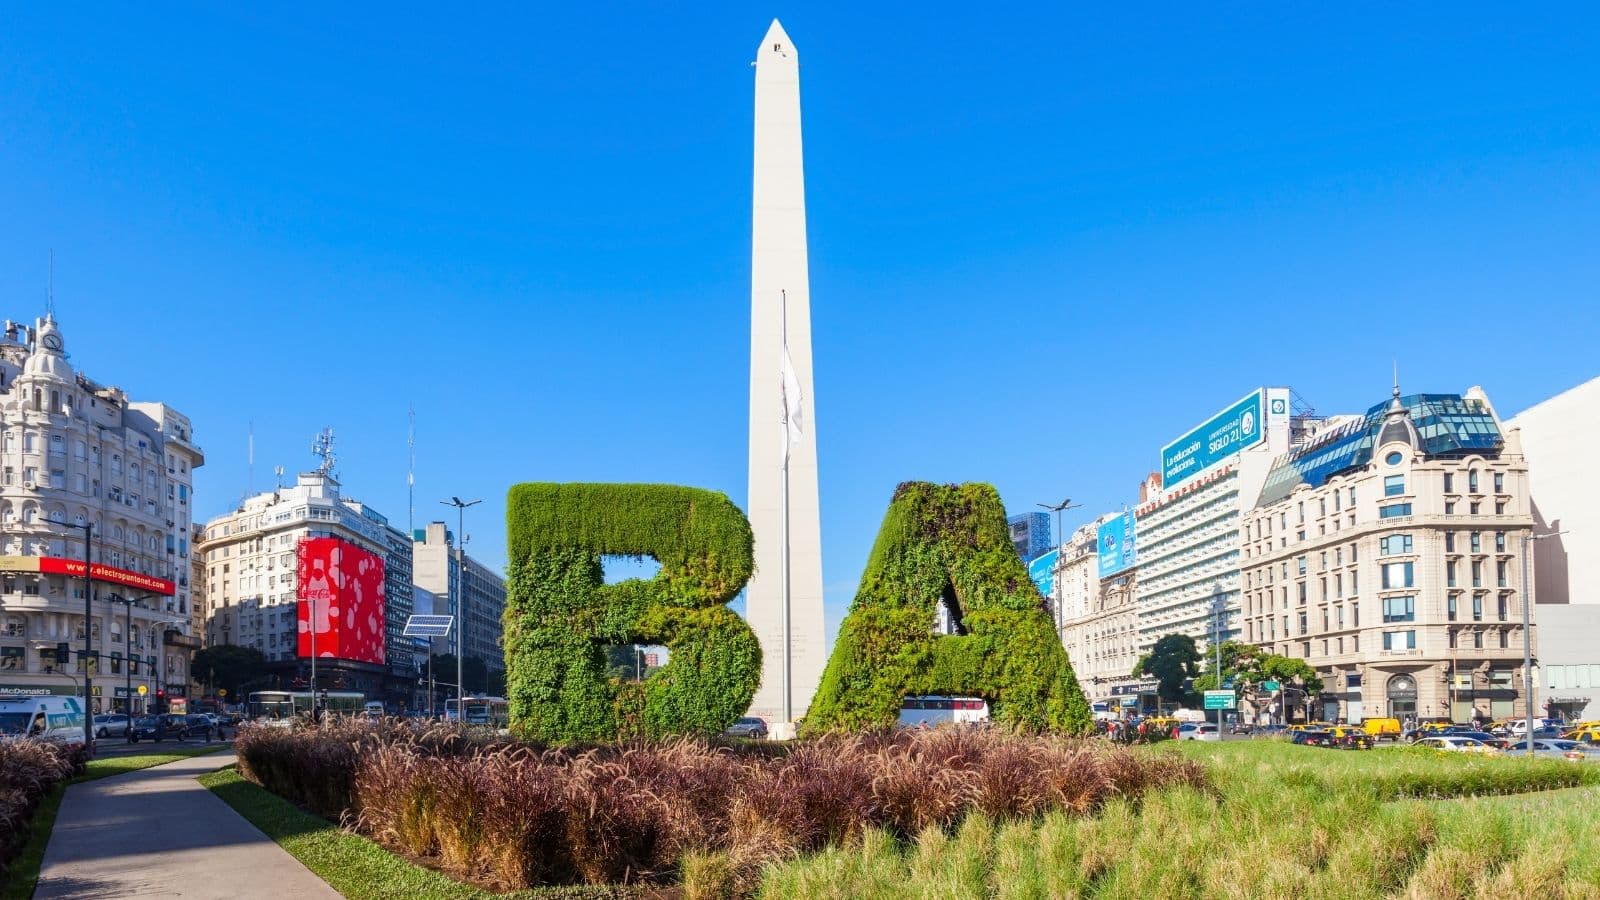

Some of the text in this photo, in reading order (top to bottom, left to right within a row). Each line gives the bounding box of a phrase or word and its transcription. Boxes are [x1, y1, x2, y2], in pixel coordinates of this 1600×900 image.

[1209, 418, 1239, 440] UNIVERSIDAD
[1209, 428, 1240, 455] SIGLO 21
[1166, 440, 1201, 467] La educación
